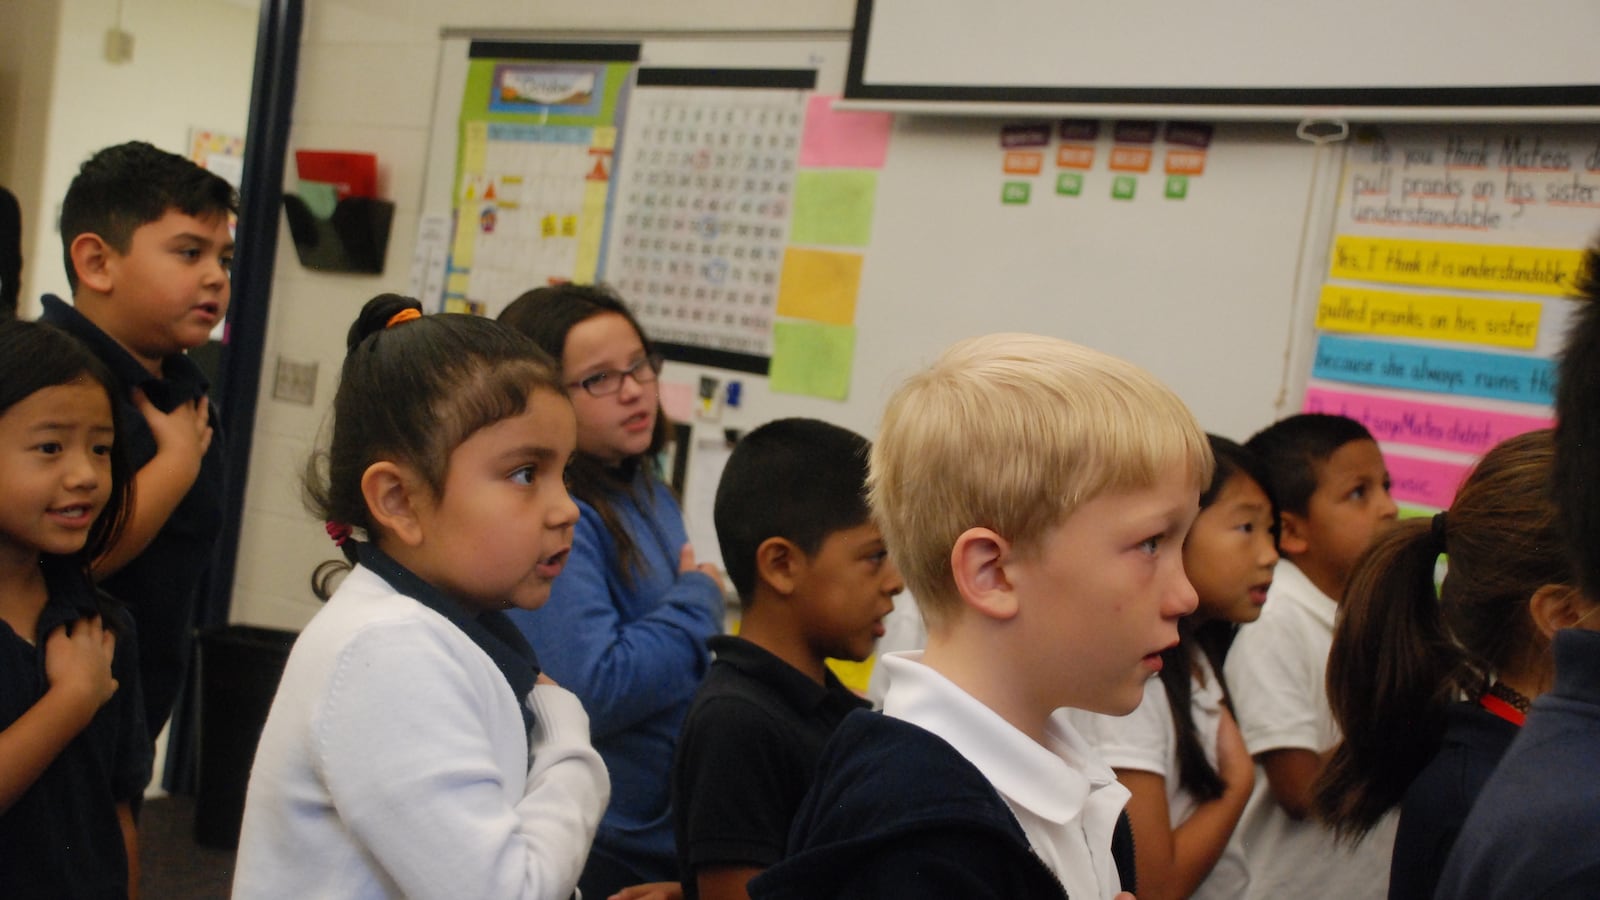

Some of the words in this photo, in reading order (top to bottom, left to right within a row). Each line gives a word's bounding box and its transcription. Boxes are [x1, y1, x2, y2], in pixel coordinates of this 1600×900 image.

[1404, 150, 1434, 173] you
[1444, 136, 1488, 167] think
[1352, 168, 1394, 204] pull
[1401, 171, 1464, 204] pranks
[1504, 170, 1537, 199] his
[1384, 247, 1421, 273] think
[1425, 251, 1441, 274] it
[1457, 252, 1567, 286] understandable
[1319, 297, 1368, 325] pulled
[1368, 302, 1425, 330] pranks
[1454, 304, 1478, 334] his
[1485, 310, 1536, 338] sister
[1316, 345, 1374, 377] because
[1382, 352, 1405, 378] she
[1411, 355, 1464, 392] always
[1473, 372, 1521, 394] ruins
